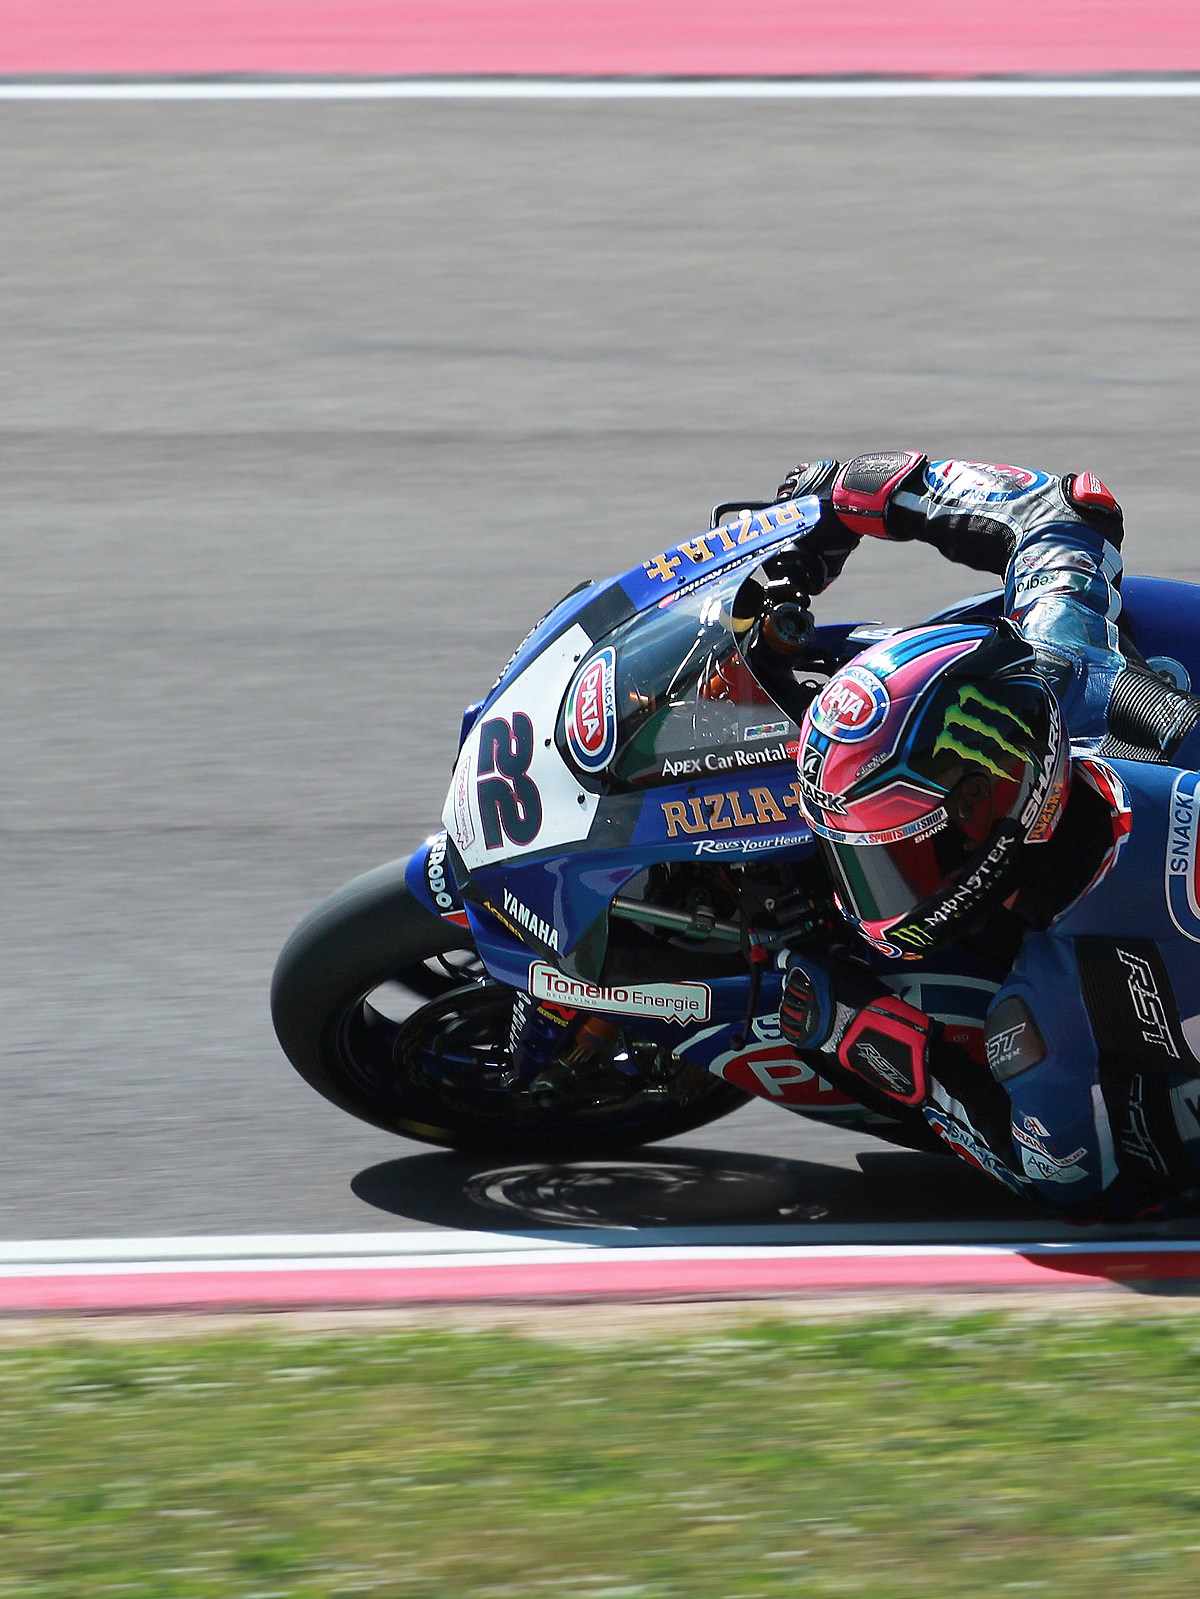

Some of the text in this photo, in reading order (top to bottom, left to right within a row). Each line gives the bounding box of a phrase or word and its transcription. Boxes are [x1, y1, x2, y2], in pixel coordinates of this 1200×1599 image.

[580, 673, 602, 744] PATA
[603, 667, 615, 717] SNACK
[828, 682, 867, 722] PATA
[477, 712, 543, 850] 22
[706, 752, 735, 771] Car
[1020, 702, 1060, 829] SHARK
[692, 841, 739, 855] Revs
[740, 837, 776, 852] Your
[775, 834, 814, 847] Heart
[914, 821, 949, 844] SHARK
[1169, 791, 1195, 874] SNACK
[424, 829, 453, 909] FERODO
[924, 835, 1015, 926] MONSTER
[503, 888, 559, 951] YAMAHA
[540, 971, 699, 1012] Tonello Energie
[1116, 947, 1180, 1059] RST
[856, 1042, 911, 1086] RST
[985, 1022, 1026, 1059] ST
